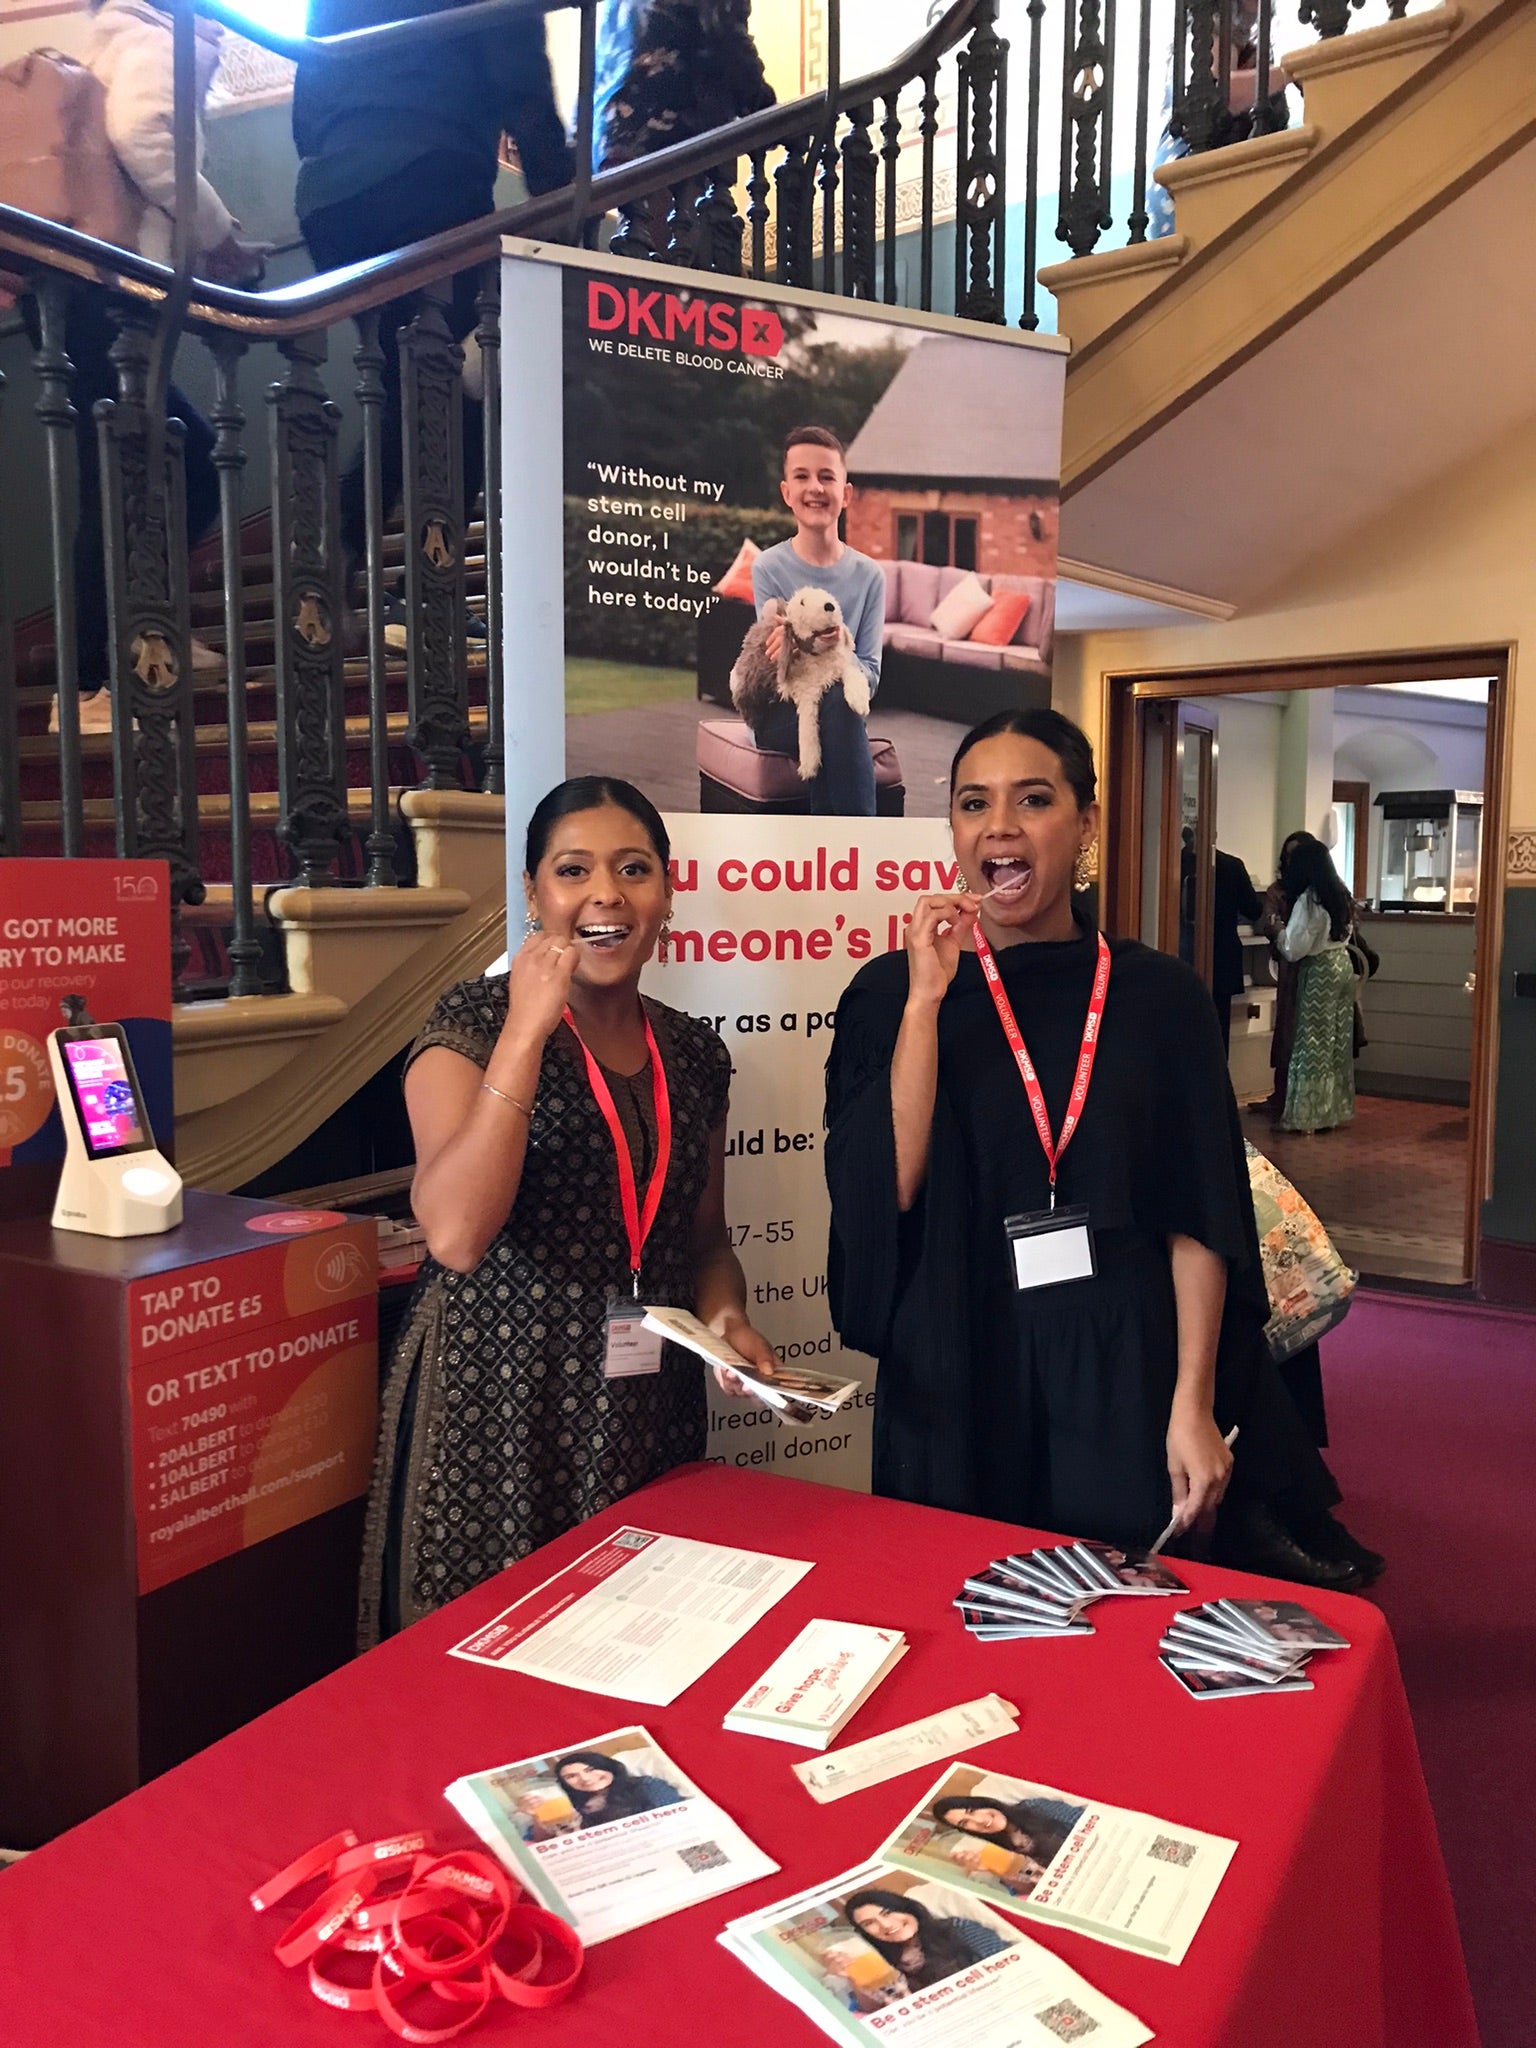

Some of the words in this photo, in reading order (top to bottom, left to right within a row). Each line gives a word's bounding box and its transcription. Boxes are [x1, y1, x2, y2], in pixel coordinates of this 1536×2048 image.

[588, 280, 738, 351] DKMS
[589, 337, 613, 354] WE
[617, 342, 671, 364] DELETE
[675, 350, 723, 372] BLOOD
[726, 360, 784, 380] CANCER
[588, 461, 687, 493] “Without
[693, 480, 725, 502] my
[588, 496, 643, 519] stem
[649, 502, 686, 522] cell
[588, 525, 657, 551] donor,
[662, 531, 669, 550] I
[588, 558, 680, 582] wouldn’t
[686, 564, 711, 585] be
[588, 584, 636, 607] here
[643, 590, 720, 616] today!”
[717, 847, 859, 892] could
[875, 860, 959, 892] sav
[4, 919, 52, 939] GOT
[57, 917, 118, 937] MORE
[652, 914, 871, 963] meone’s
[32, 946, 62, 966] TO
[67, 944, 126, 964] MAKE
[11, 978, 35, 990] our
[38, 974, 97, 988] recovery
[1095, 955, 1108, 1000] VOLUNTEER
[12, 993, 51, 1009] today
[995, 993, 1017, 1040] VOLUNTEER
[736, 1014, 770, 1033] as
[780, 1012, 797, 1031] a
[4, 1036, 50, 1090] DONATE
[1074, 1053, 1091, 1101] VOLUNTEER
[0, 1066, 26, 1102] 5
[775, 1127, 814, 1153] be:
[1032, 1095, 1051, 1149] VOLUNTEER
[727, 1221, 794, 1247] 17-55
[140, 1286, 184, 1316] TAP
[188, 1276, 221, 1299] TO
[754, 1281, 794, 1304] the
[142, 1301, 234, 1348] DONATE
[239, 1295, 262, 1319] £5
[146, 1379, 180, 1406] OR
[184, 1358, 241, 1394] TEXT
[246, 1348, 276, 1373] TO
[279, 1319, 358, 1364] DONATE
[772, 1332, 832, 1363] good
[148, 1422, 179, 1443] Text
[181, 1403, 227, 1432] 70490
[159, 1425, 237, 1468] 20ALBERT
[159, 1445, 237, 1488] 10ALBERT
[735, 1441, 775, 1467] cell
[784, 1433, 852, 1459] donor
[150, 1450, 346, 1543] royalalberthall.com/support
[160, 1468, 229, 1510] 5ALBERT
[775, 1691, 803, 1713] Give
[536, 1843, 558, 1853] Be
[562, 1837, 572, 1846] a
[577, 1826, 618, 1841] stem
[622, 1816, 650, 1828] cell
[652, 1804, 688, 1820] hero
[1034, 1889, 1053, 1903] Be
[1054, 1854, 1076, 1880] stem
[1070, 1834, 1087, 1853] cell
[1081, 1814, 1100, 1835] hero
[870, 2012, 896, 2029] Be
[897, 2006, 910, 2016] a
[912, 1985, 954, 2009] stem
[955, 1968, 984, 1989] cell
[983, 1953, 1021, 1974] hero
